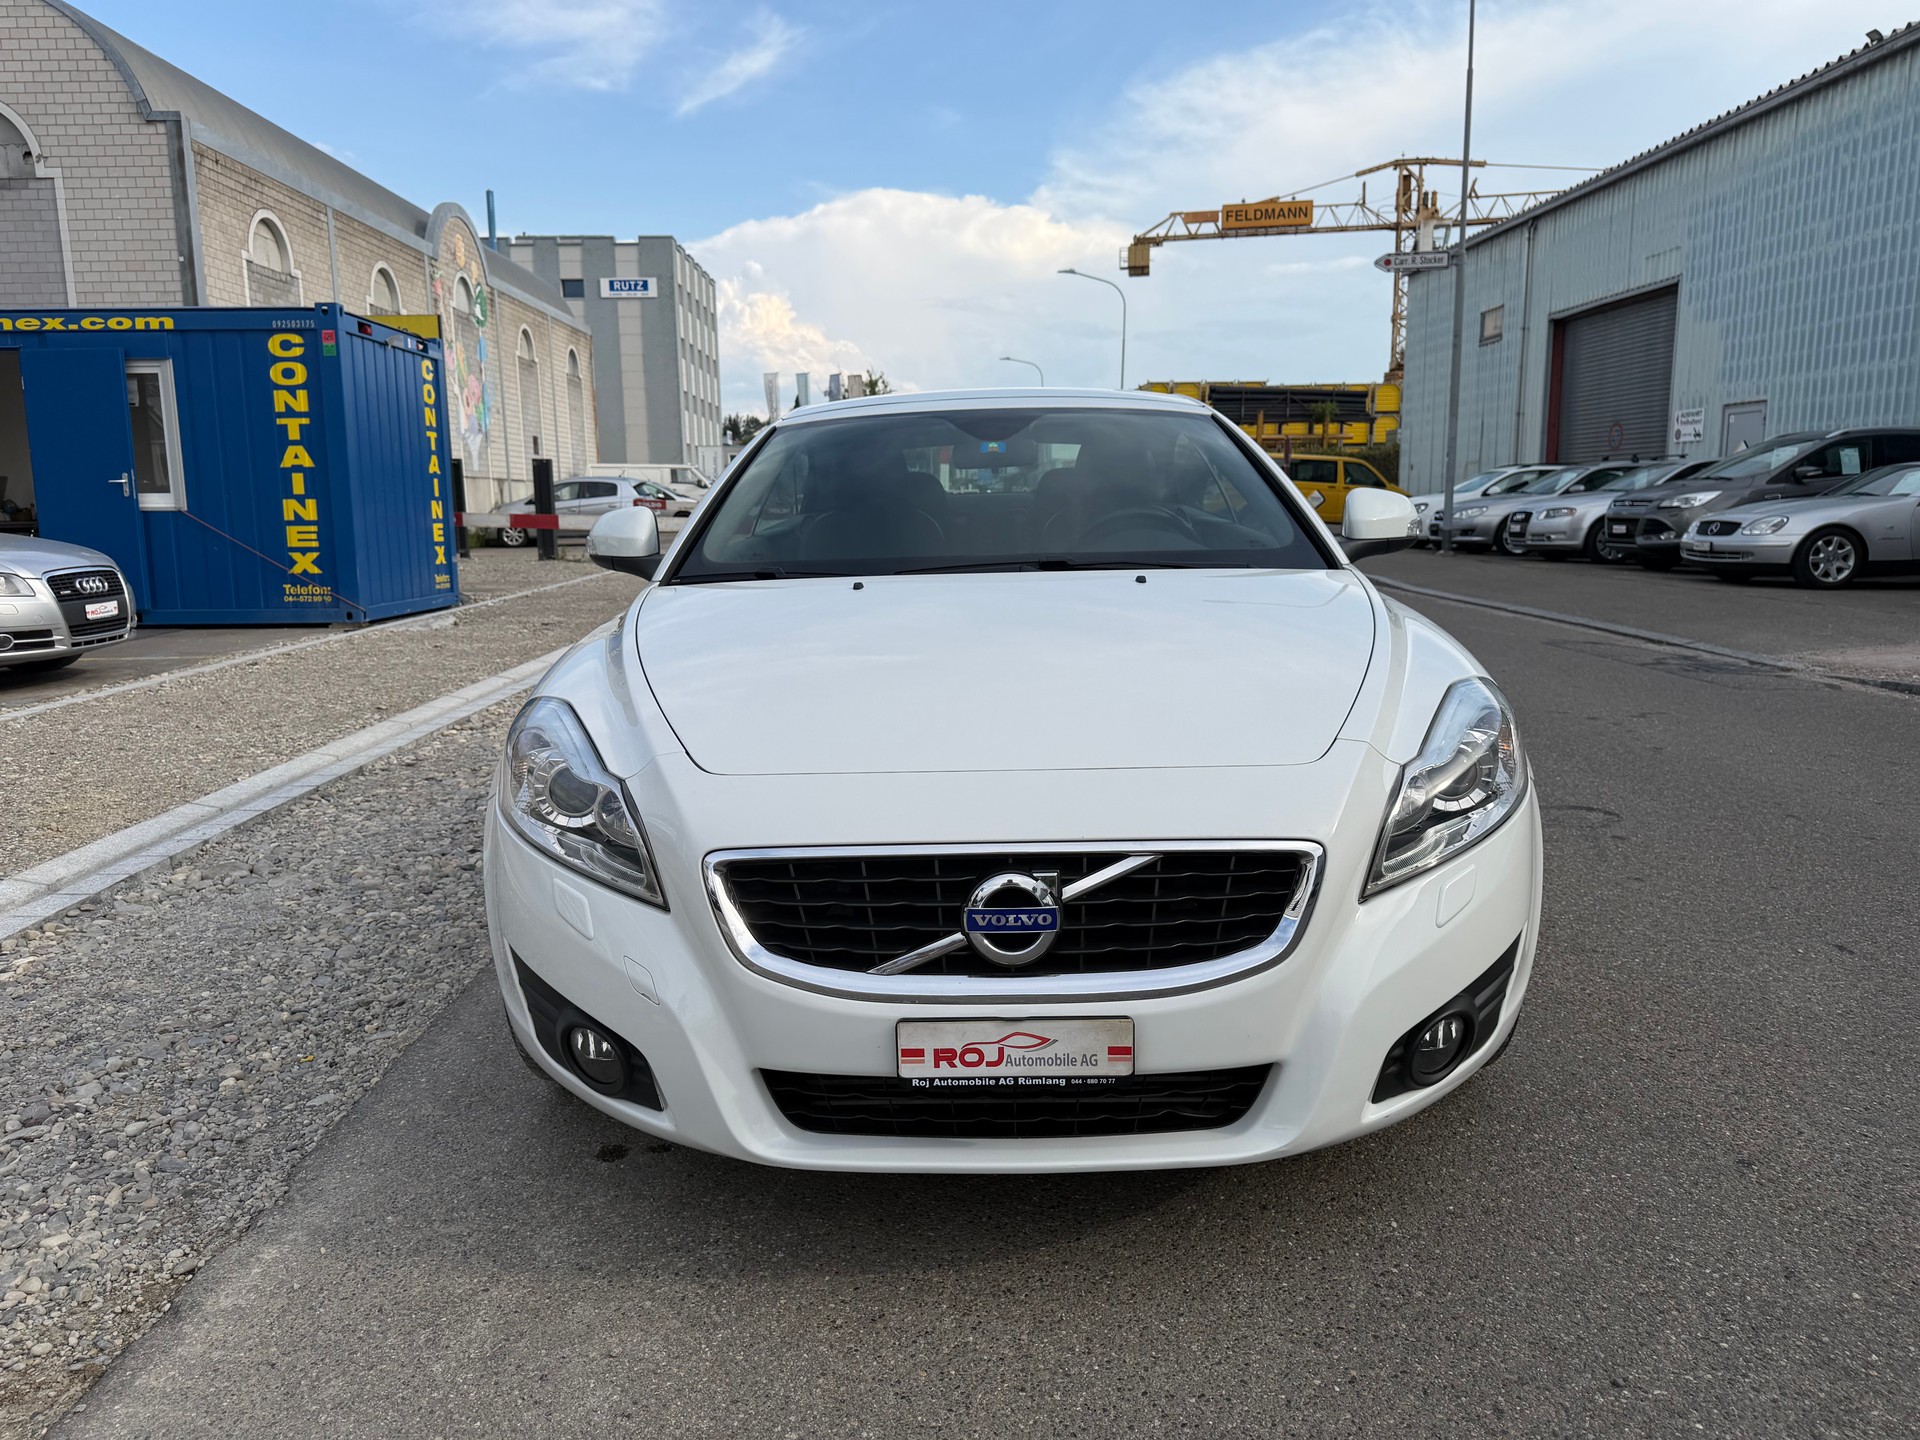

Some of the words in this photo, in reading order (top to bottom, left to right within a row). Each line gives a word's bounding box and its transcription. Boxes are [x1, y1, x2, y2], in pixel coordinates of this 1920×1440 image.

[1226, 206, 1308, 222] FELDMANN
[613, 281, 644, 291] RUTZ
[268, 333, 323, 574] CONTAINEX
[422, 360, 447, 565] CONTAINEX
[283, 584, 331, 594] Telefon:
[972, 914, 1052, 926] VOLVO
[933, 1047, 1004, 1068] ROJ
[1005, 1053, 1077, 1067] Automobile
[1080, 1053, 1098, 1067] AG
[912, 1079, 929, 1088] Roj
[933, 1077, 996, 1086] Automobile
[999, 1077, 1014, 1085] AG
[1018, 1077, 1066, 1086] Rümlang
